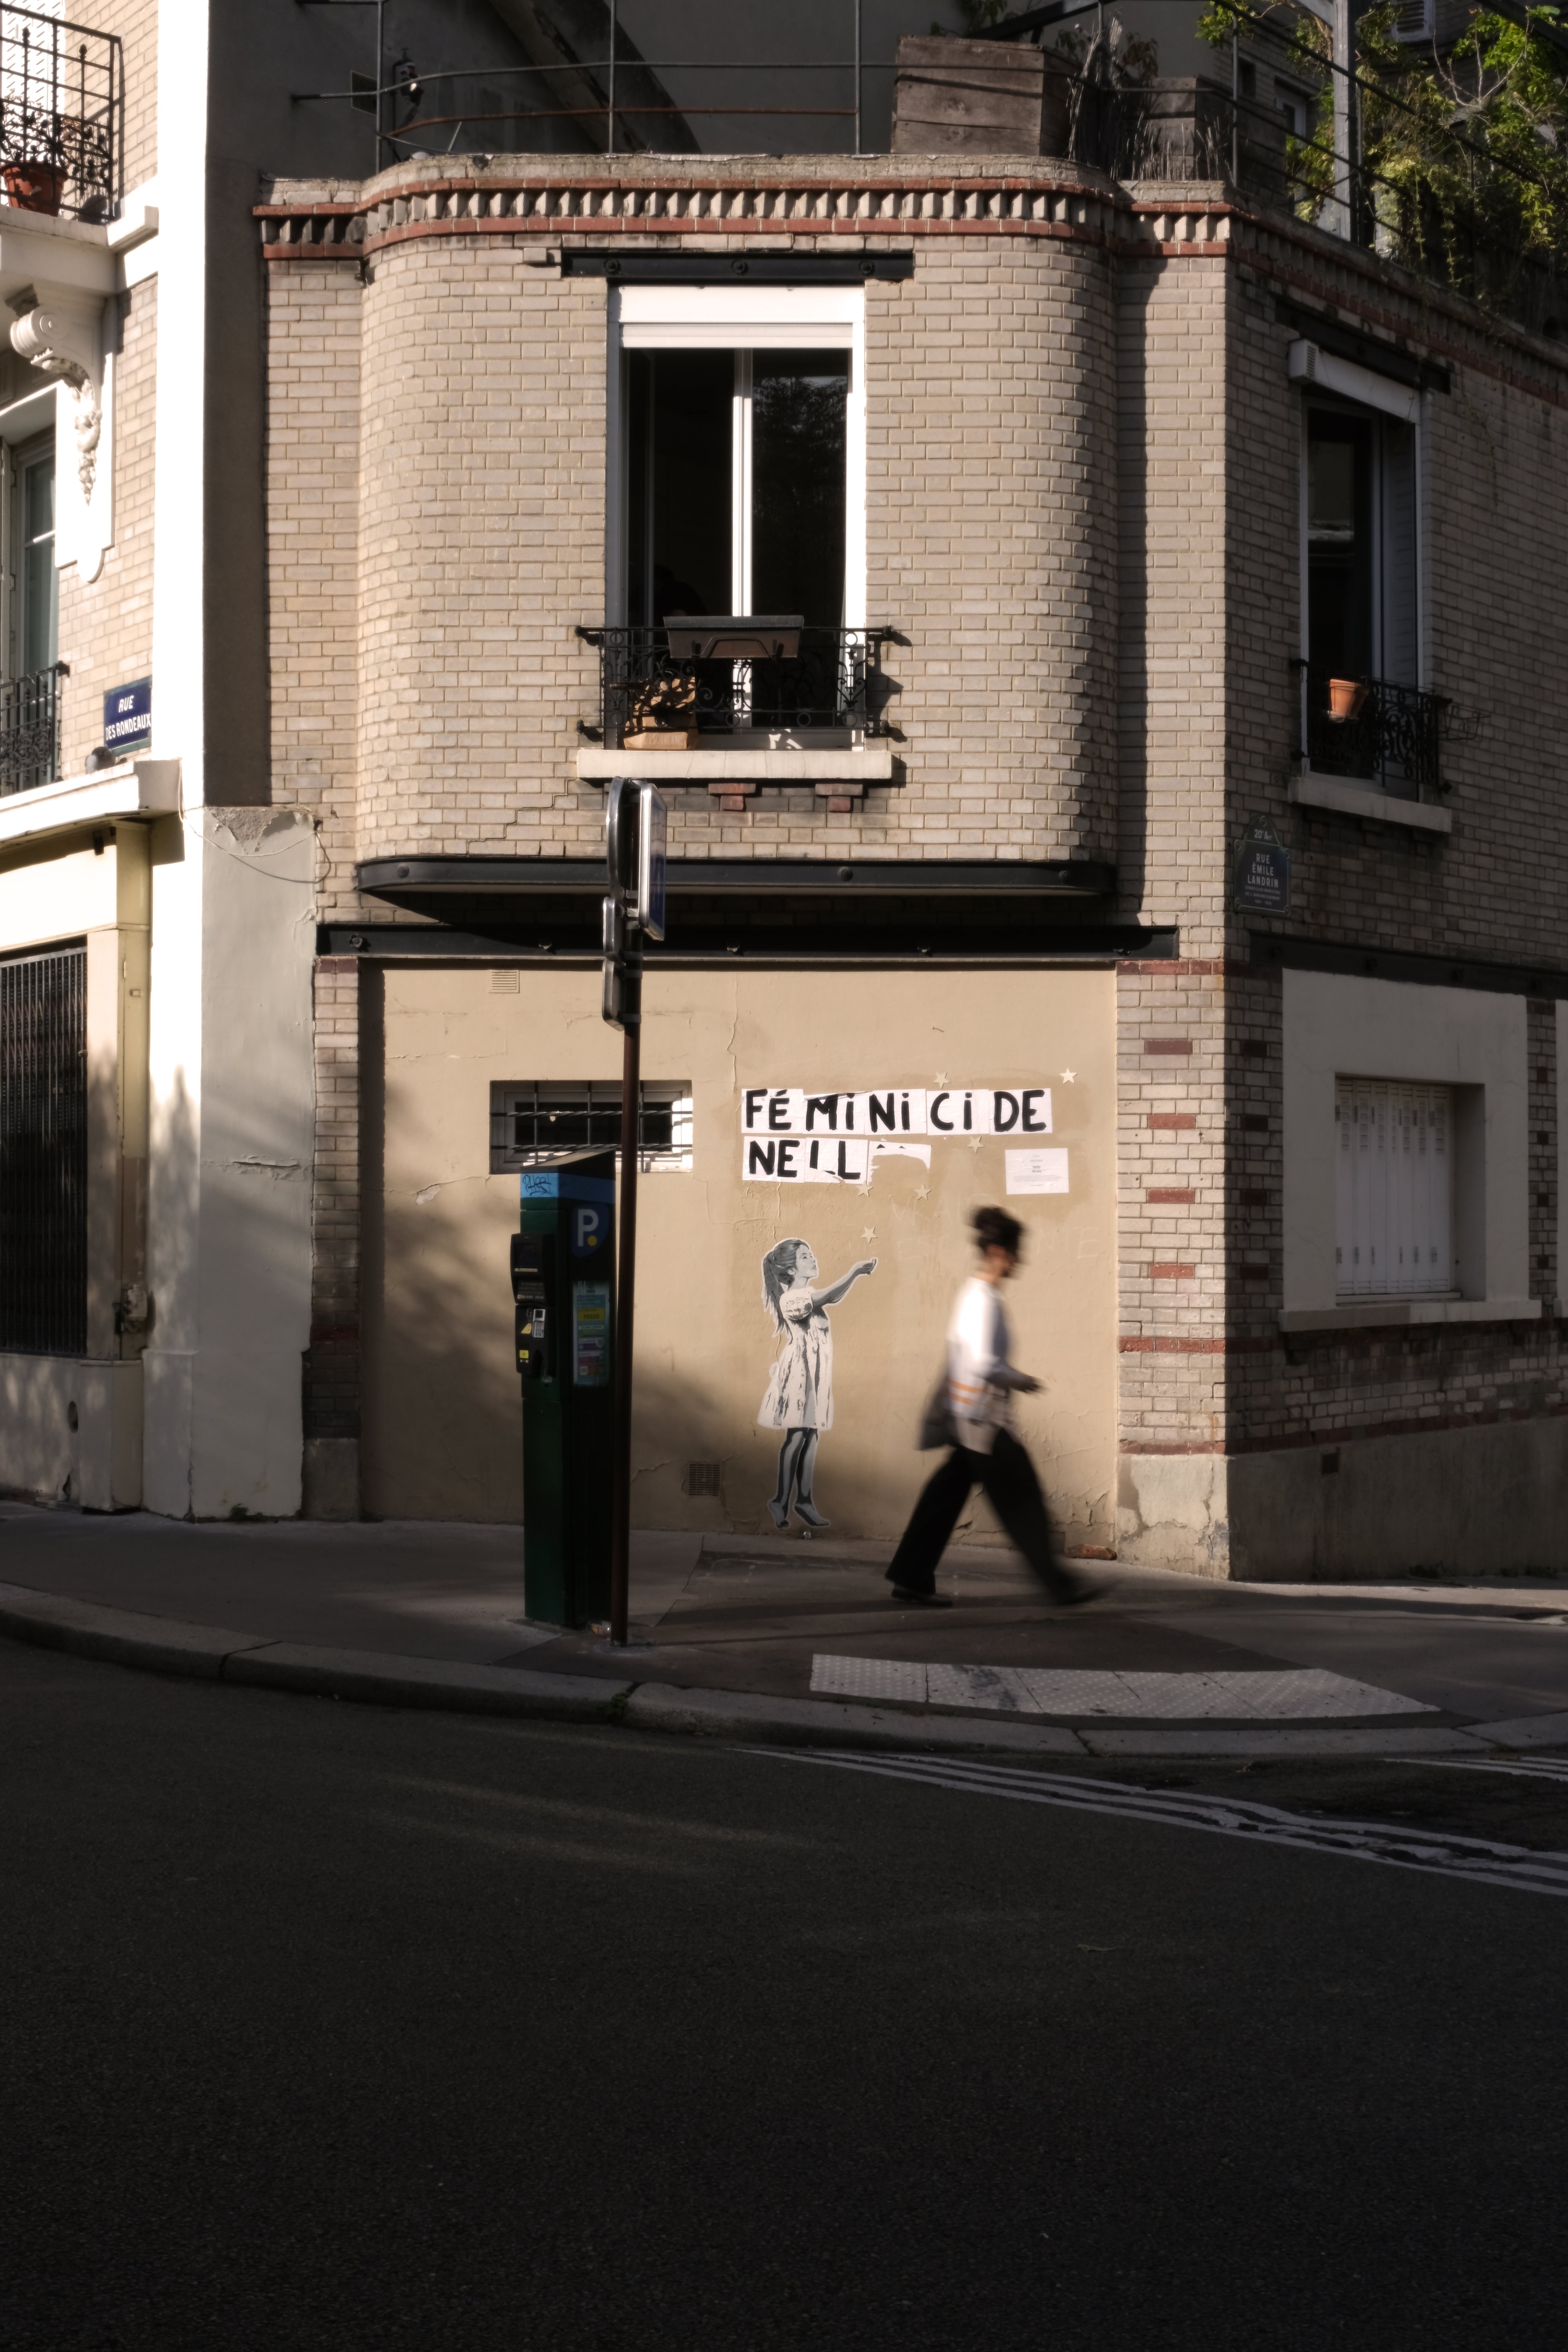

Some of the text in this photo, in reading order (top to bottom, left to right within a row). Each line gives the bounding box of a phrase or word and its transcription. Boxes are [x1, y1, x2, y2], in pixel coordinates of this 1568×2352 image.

[118, 695, 134, 713] RUE
[105, 713, 151, 741] DES RONDEAUX
[1256, 853, 1270, 864] RUE
[1252, 862, 1274, 876] ÉMILE
[1247, 875, 1278, 888] LANDRIN
[746, 1089, 1047, 1132] FÉMINICIDE
[578, 1209, 599, 1247] P
